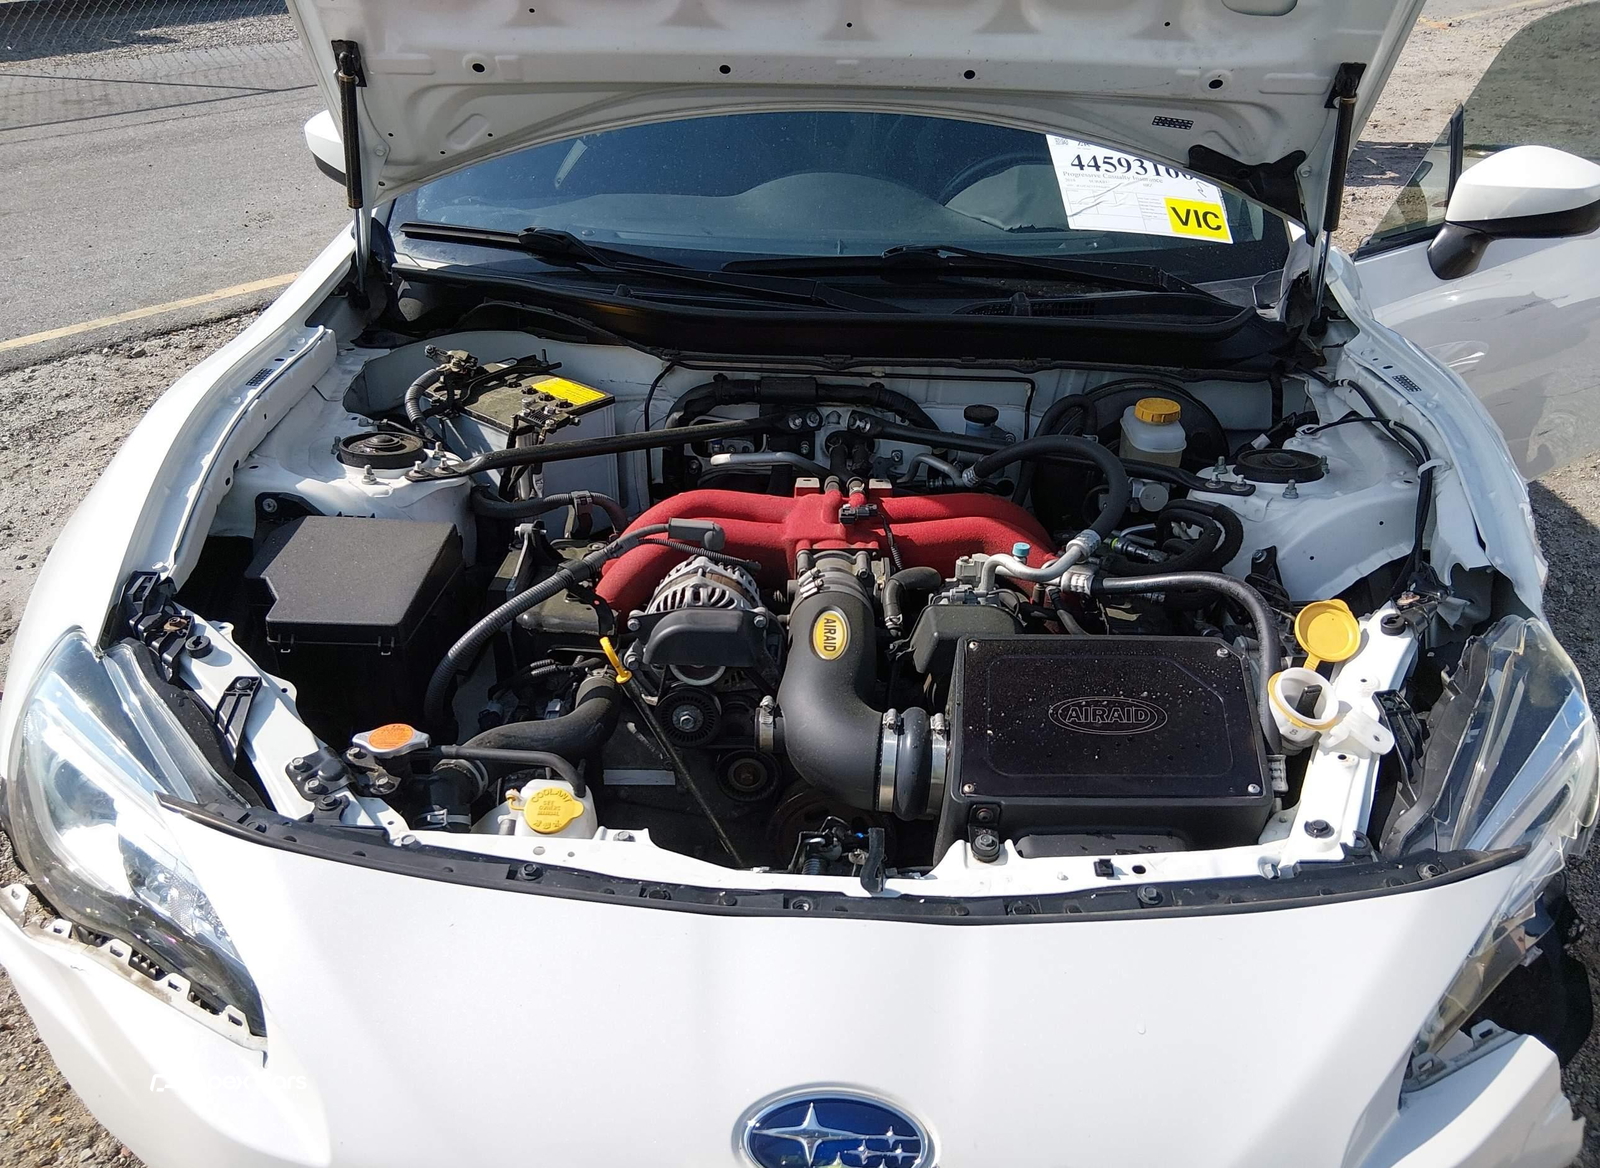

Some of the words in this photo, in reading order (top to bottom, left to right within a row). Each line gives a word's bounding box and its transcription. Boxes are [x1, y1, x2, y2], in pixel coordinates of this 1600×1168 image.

[1062, 171, 1101, 179] Progressive
[1102, 173, 1131, 181] Casualty
[1170, 206, 1222, 231] VIC
[823, 617, 837, 652] AIRAID
[1065, 706, 1151, 724] AIRAID
[532, 788, 572, 802] COOLANT
